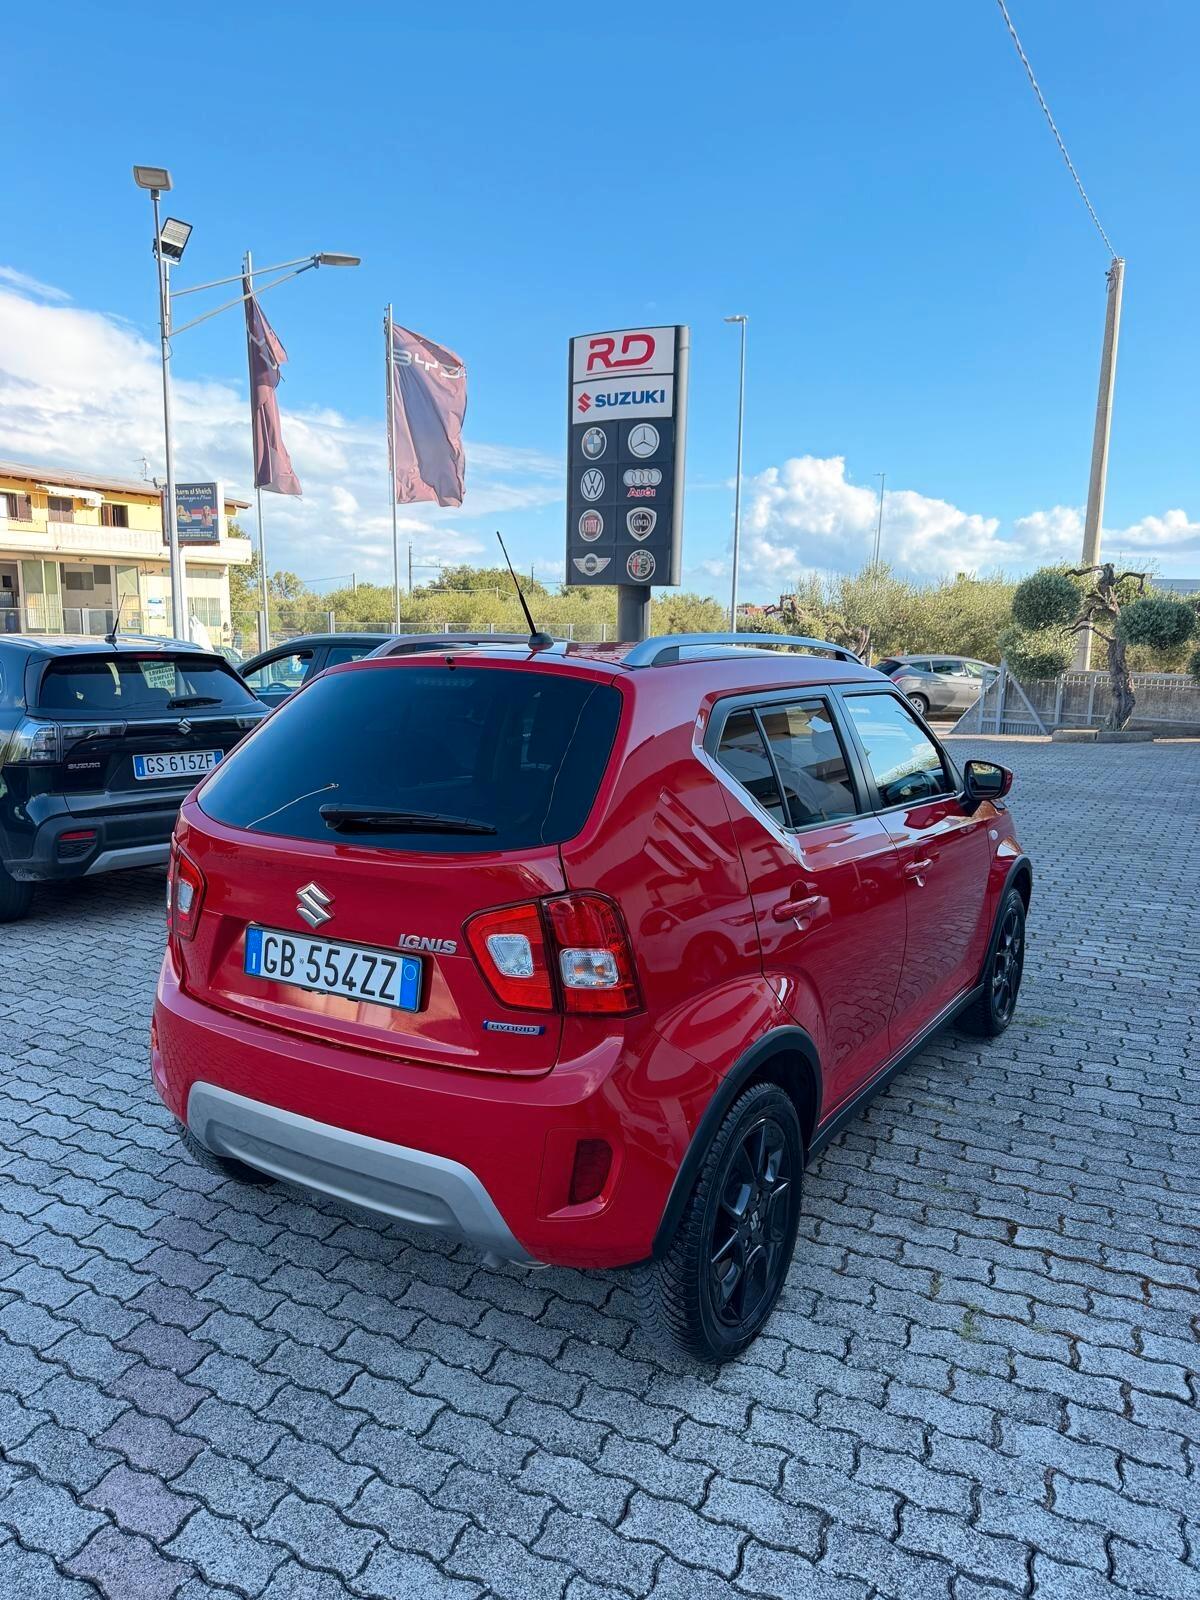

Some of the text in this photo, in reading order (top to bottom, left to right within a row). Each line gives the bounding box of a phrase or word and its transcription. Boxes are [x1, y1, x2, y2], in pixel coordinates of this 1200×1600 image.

[587, 334, 655, 371] RD
[595, 389, 665, 408] SUZUKI
[627, 487, 656, 498] Audi
[169, 753, 213, 771] 615ZF
[398, 934, 457, 954] IGNIS
[264, 936, 296, 977] GB
[306, 944, 397, 1000] 554ZZ
[491, 1023, 536, 1033] HYBRID
